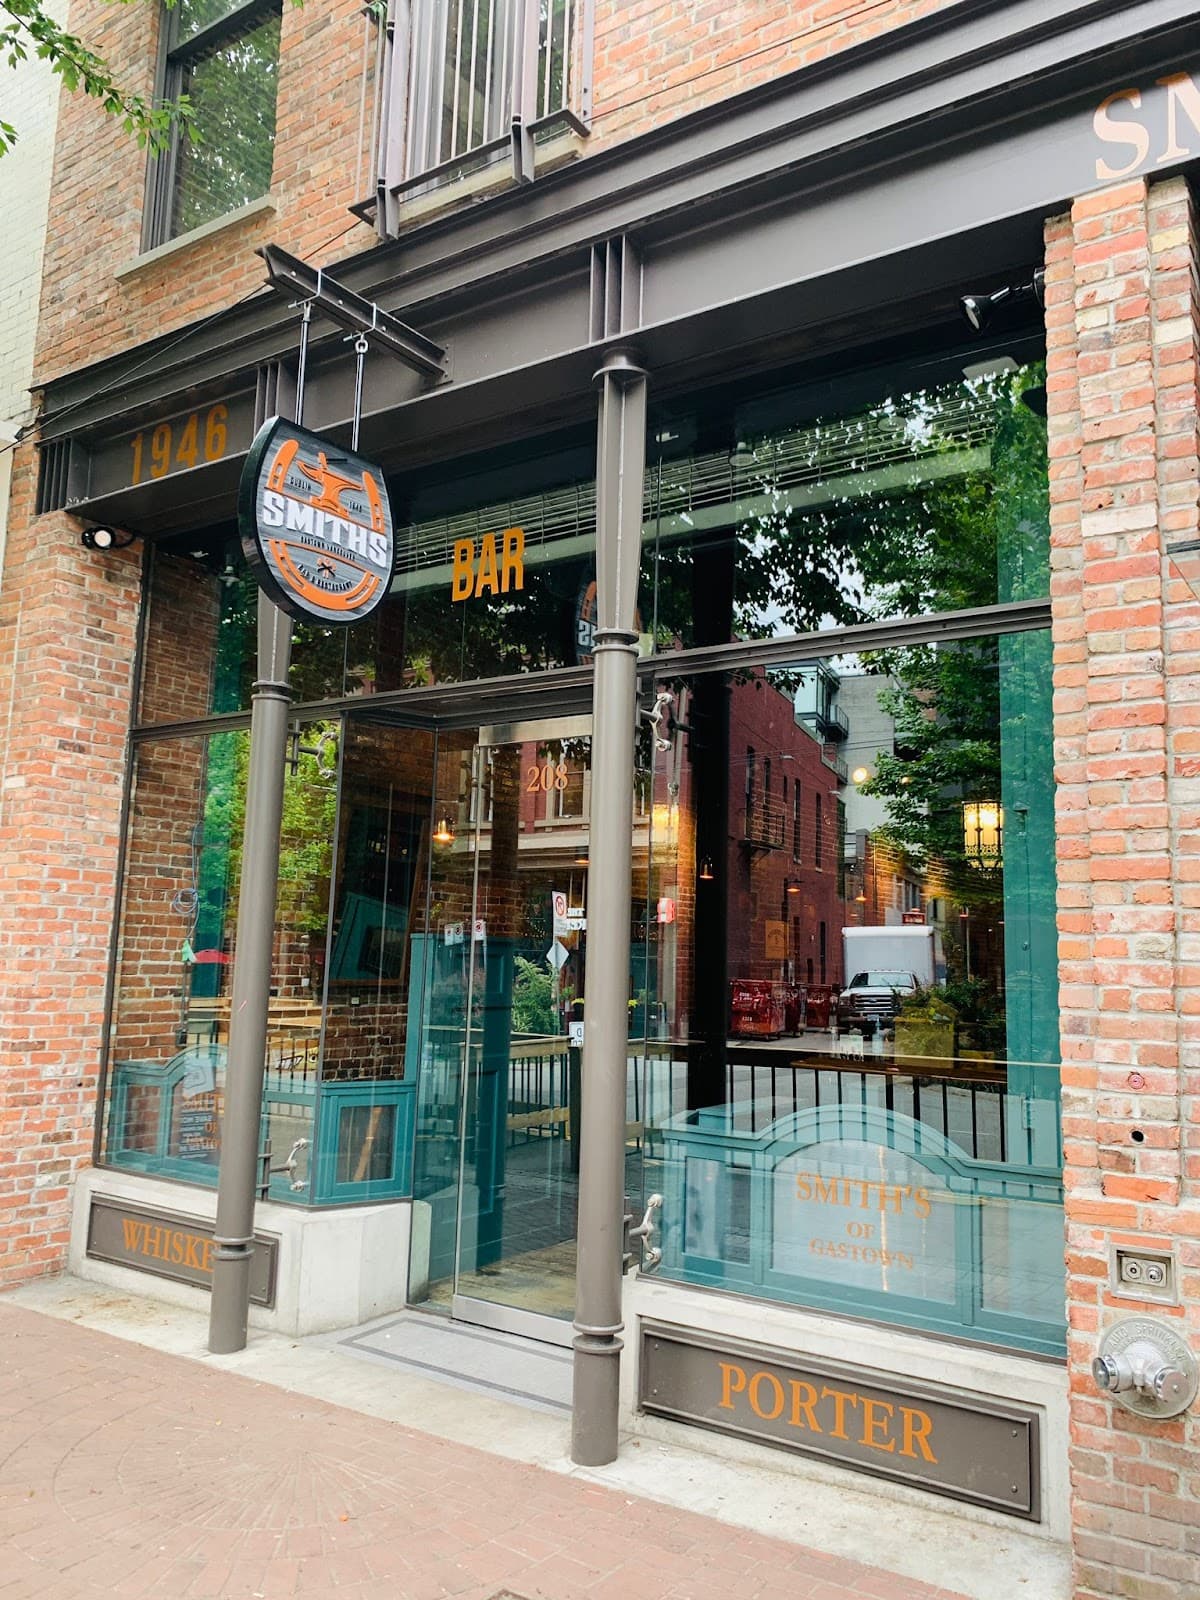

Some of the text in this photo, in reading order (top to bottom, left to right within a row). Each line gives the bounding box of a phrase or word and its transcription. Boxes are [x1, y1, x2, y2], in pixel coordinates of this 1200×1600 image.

[130, 404, 228, 485] 1946
[263, 490, 387, 567] SMITHS
[452, 526, 525, 602] BAR
[527, 764, 568, 792] 208
[796, 1171, 931, 1218] SMITH'S
[122, 1219, 216, 1273] WHISKE
[808, 1238, 914, 1270] GASTOWN
[846, 1221, 876, 1239] OF
[1108, 1326, 1129, 1347] AUTO
[717, 1361, 938, 1464] PORTER
